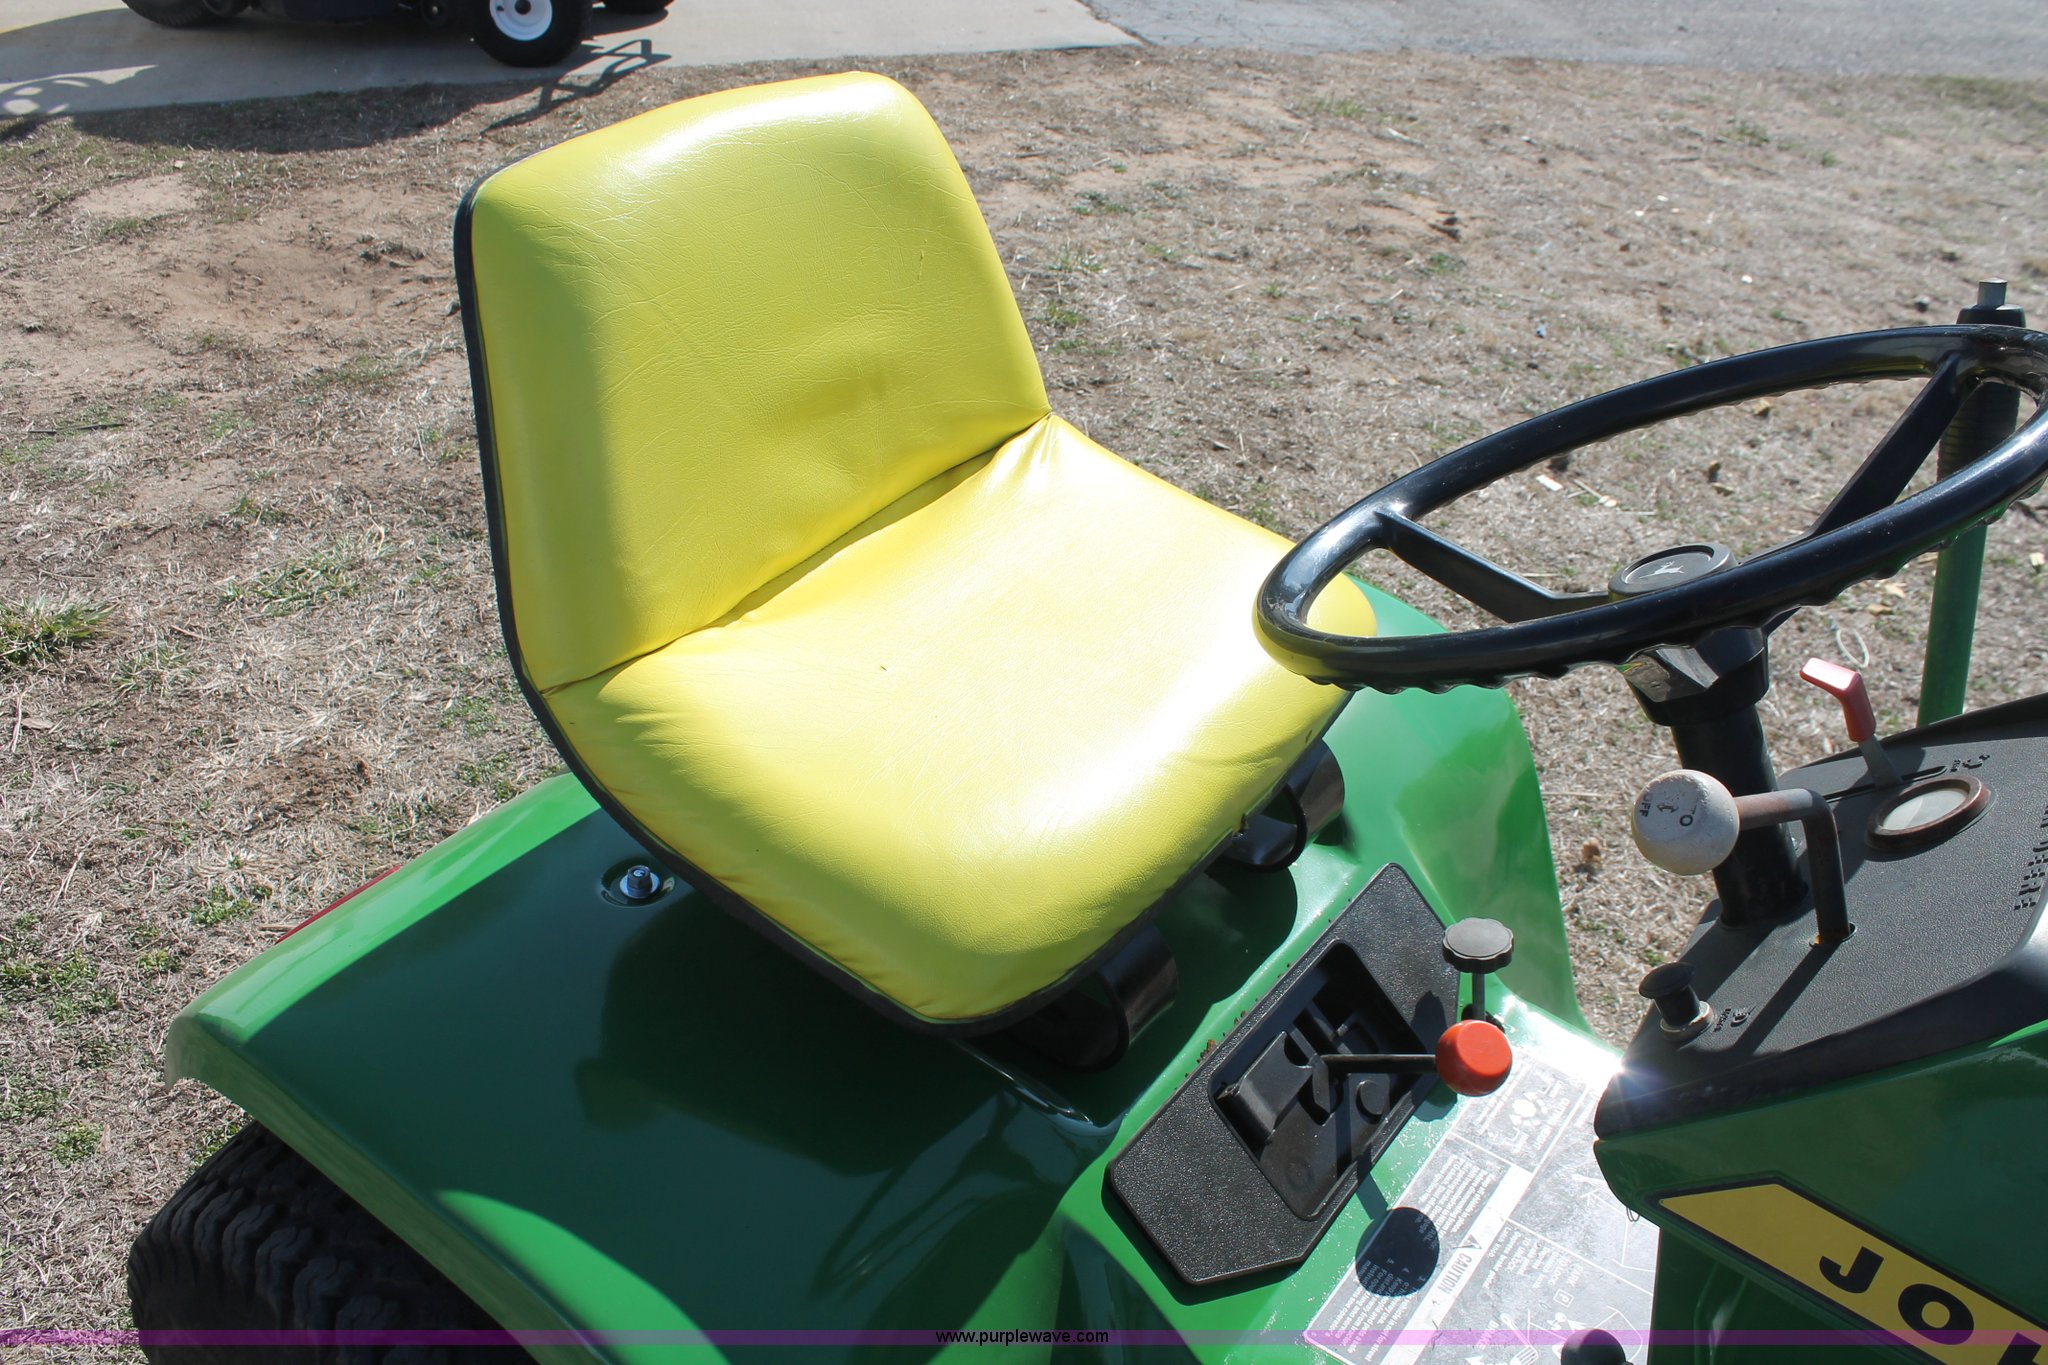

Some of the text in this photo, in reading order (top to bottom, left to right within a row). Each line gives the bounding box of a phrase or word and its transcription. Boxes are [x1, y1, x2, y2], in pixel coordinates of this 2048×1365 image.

[1480, 1172, 1494, 1188] Keep
[1465, 1193, 1481, 1212] shields
[1488, 1226, 1510, 1258] Latch knob.
[1521, 1236, 1530, 1246] TO
[1437, 1252, 1472, 1294] CAUTION
[1565, 1263, 1584, 1286] PARK
[1387, 1276, 1402, 1293] Keep
[1362, 1296, 1377, 1313] away
[1392, 1299, 1409, 1320] vehicle
[1354, 1312, 1367, 1327] from
[1367, 1312, 1378, 1324] and
[1376, 1334, 1385, 1344] for
[1475, 1320, 1498, 1350] BRAKE
[1364, 1343, 1379, 1361] street
